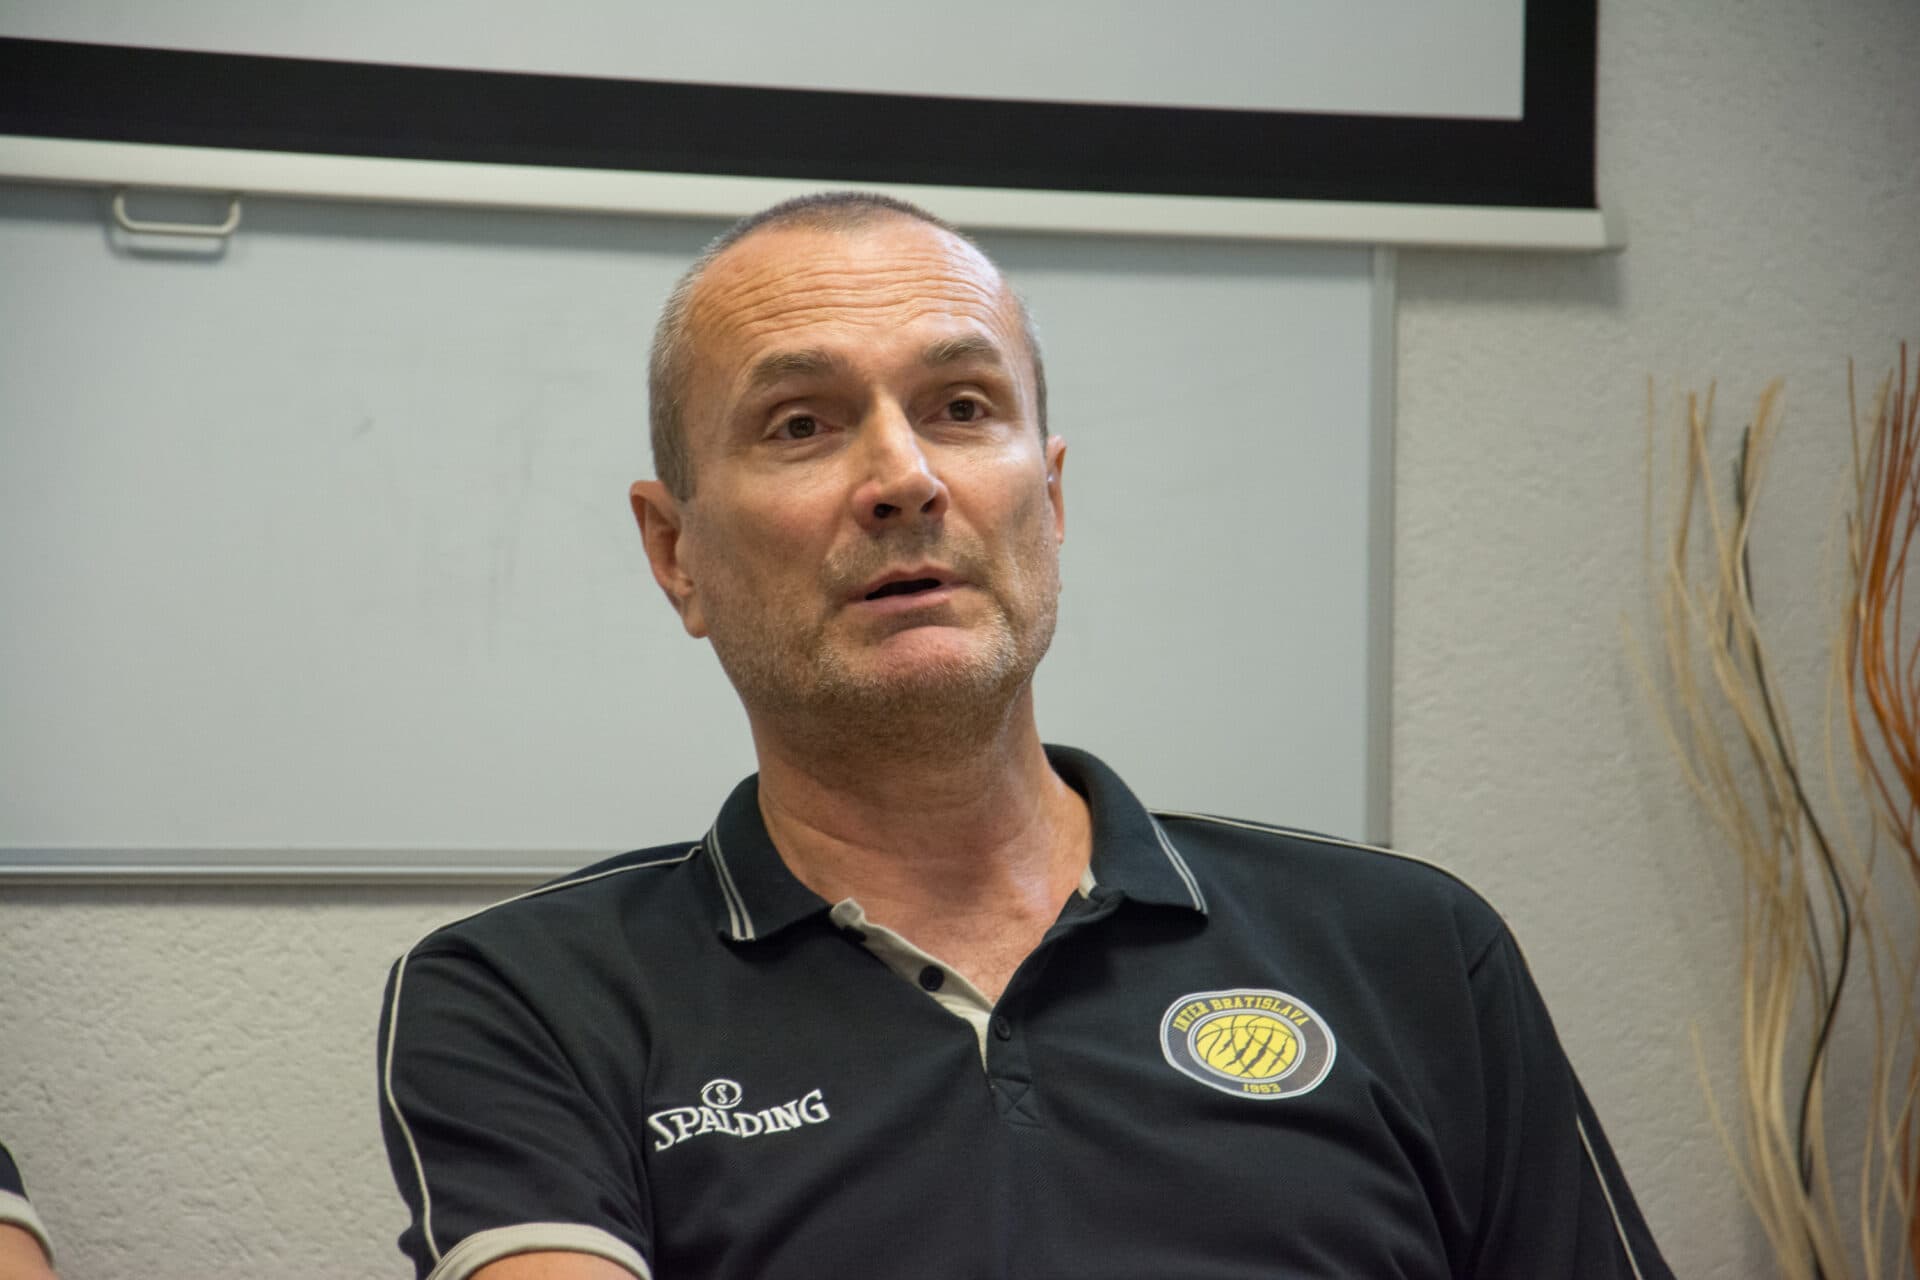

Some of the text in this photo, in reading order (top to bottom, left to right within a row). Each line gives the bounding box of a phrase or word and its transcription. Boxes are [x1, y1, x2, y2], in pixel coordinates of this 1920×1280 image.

[1172, 996, 1309, 1033] INTER BRATISLAVA
[648, 1088, 830, 1151] SPALDING
